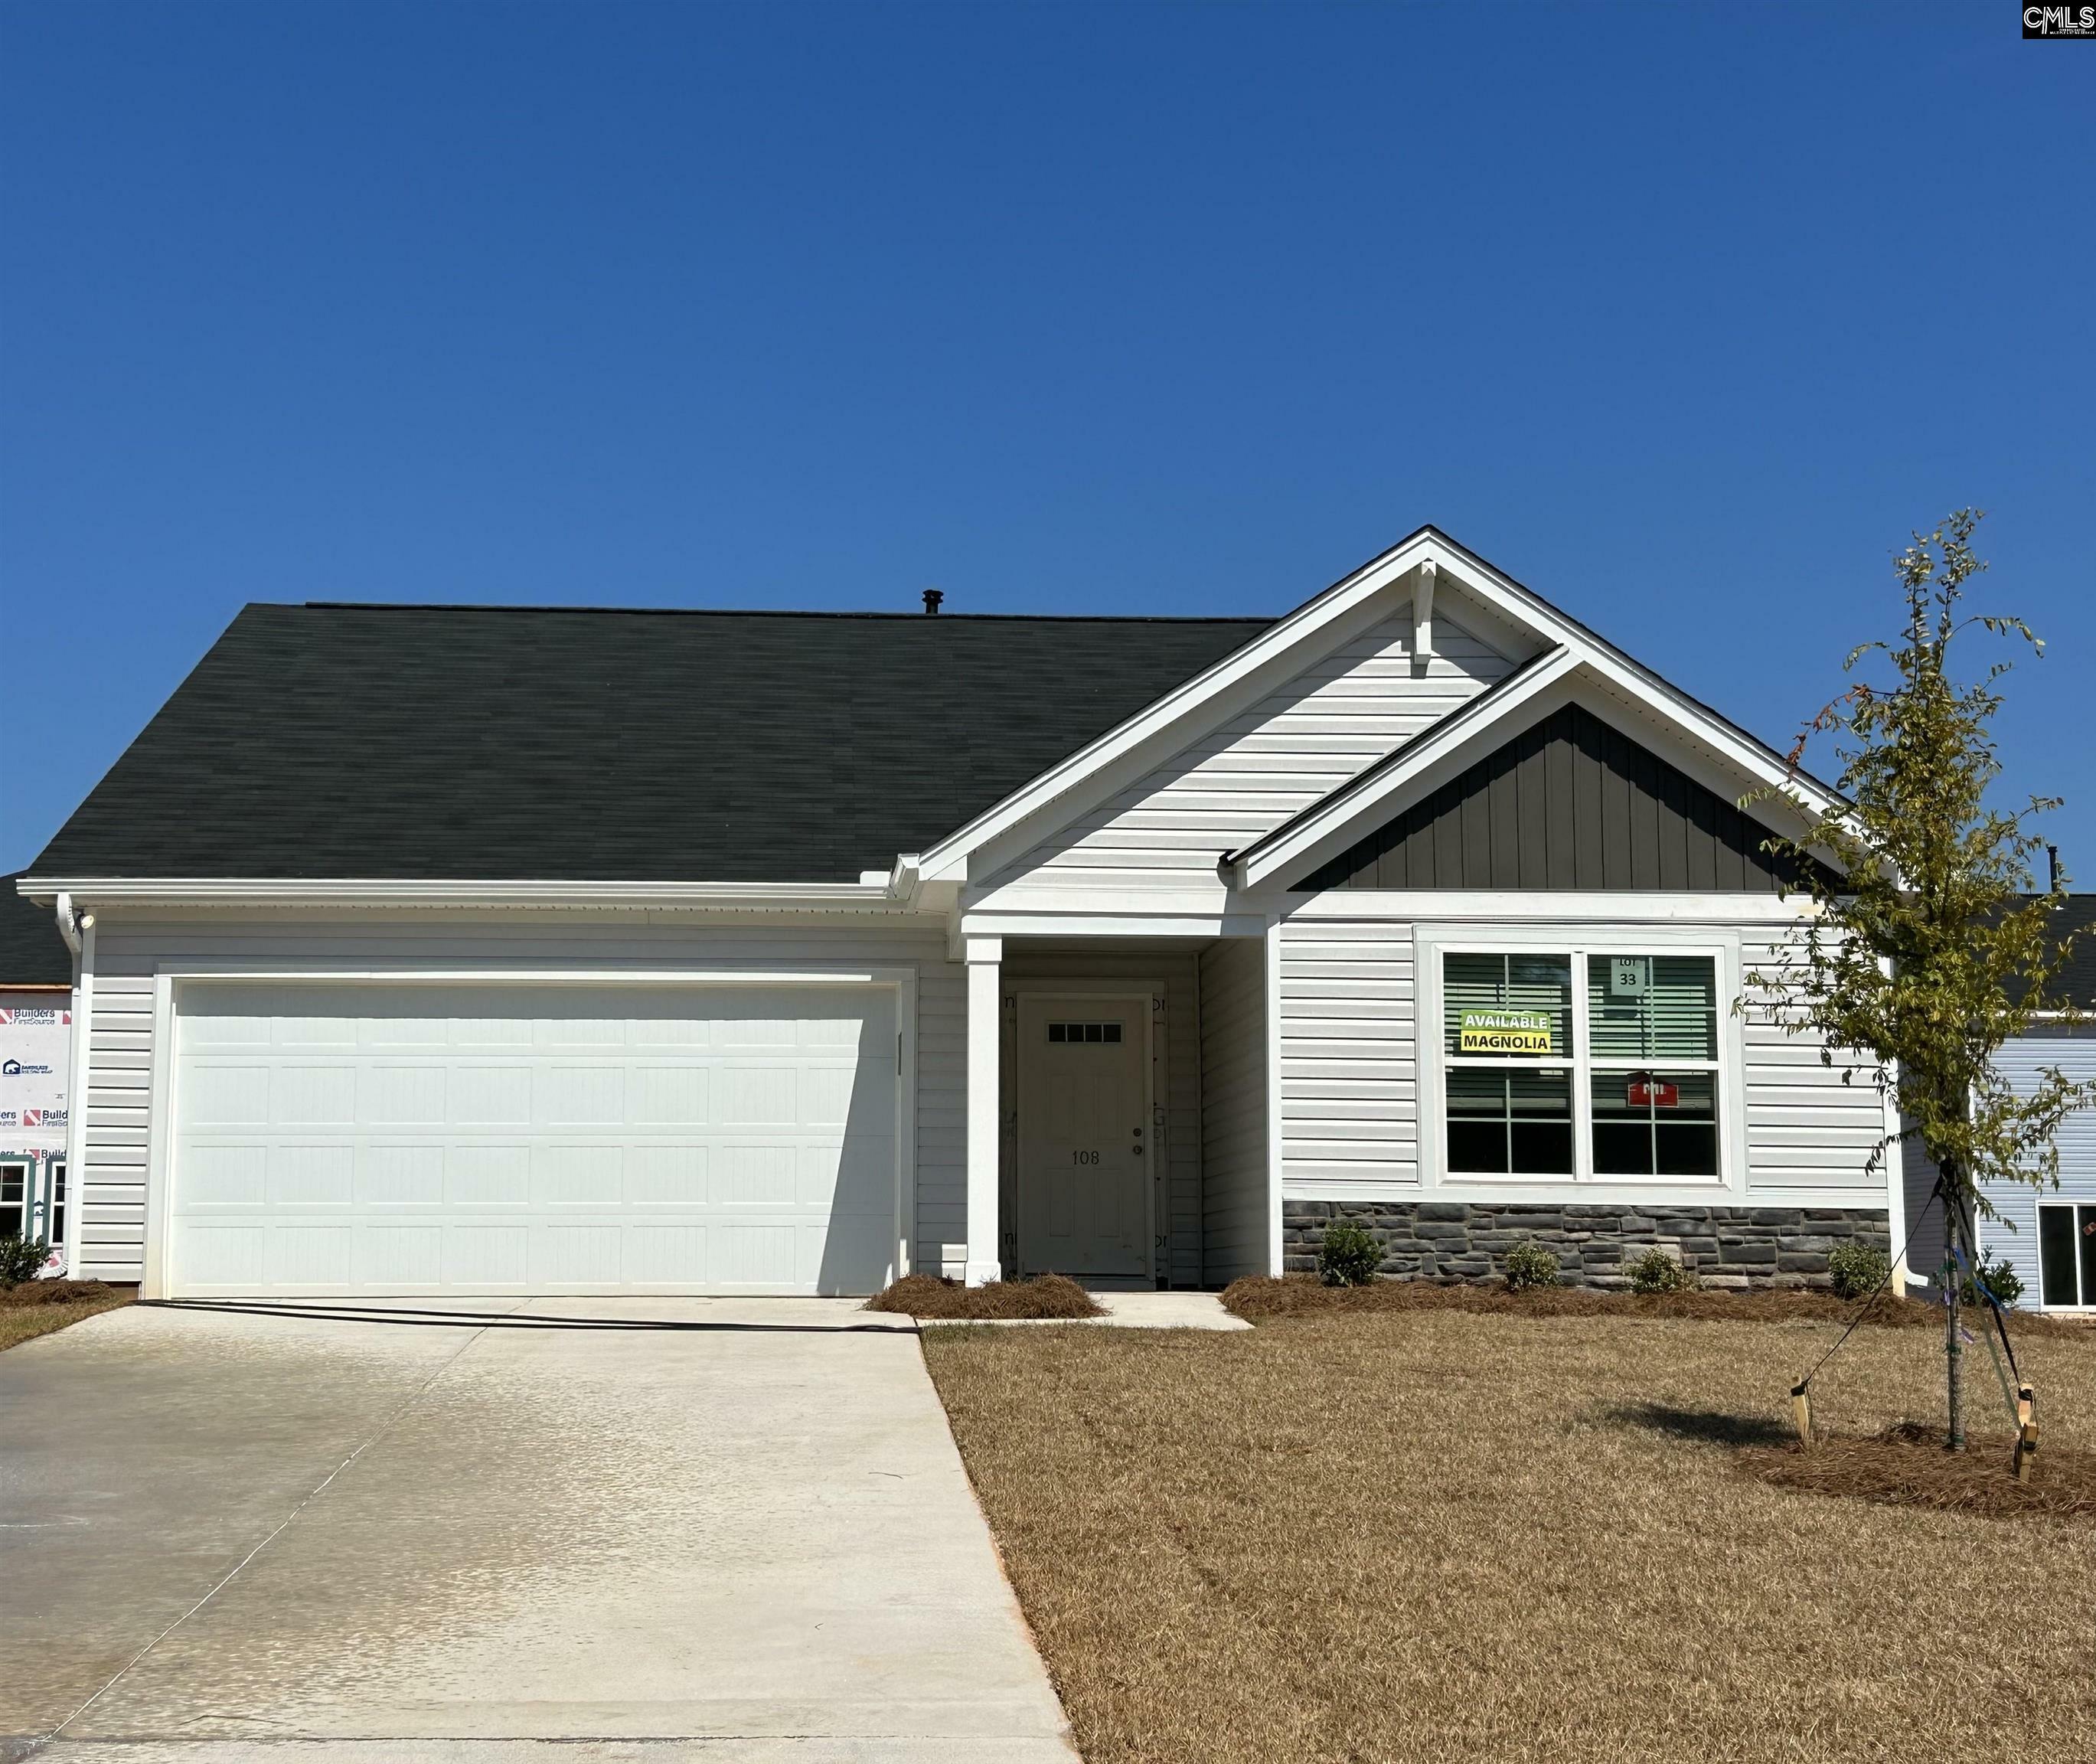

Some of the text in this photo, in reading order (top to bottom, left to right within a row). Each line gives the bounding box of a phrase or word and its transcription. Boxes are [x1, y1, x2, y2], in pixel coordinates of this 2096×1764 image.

[1620, 974, 1636, 985] 33
[1465, 1014, 1547, 1029] AVAILABLE
[1464, 1035, 1548, 1049] MAGNOLIA
[1072, 1151, 1099, 1165] 108
